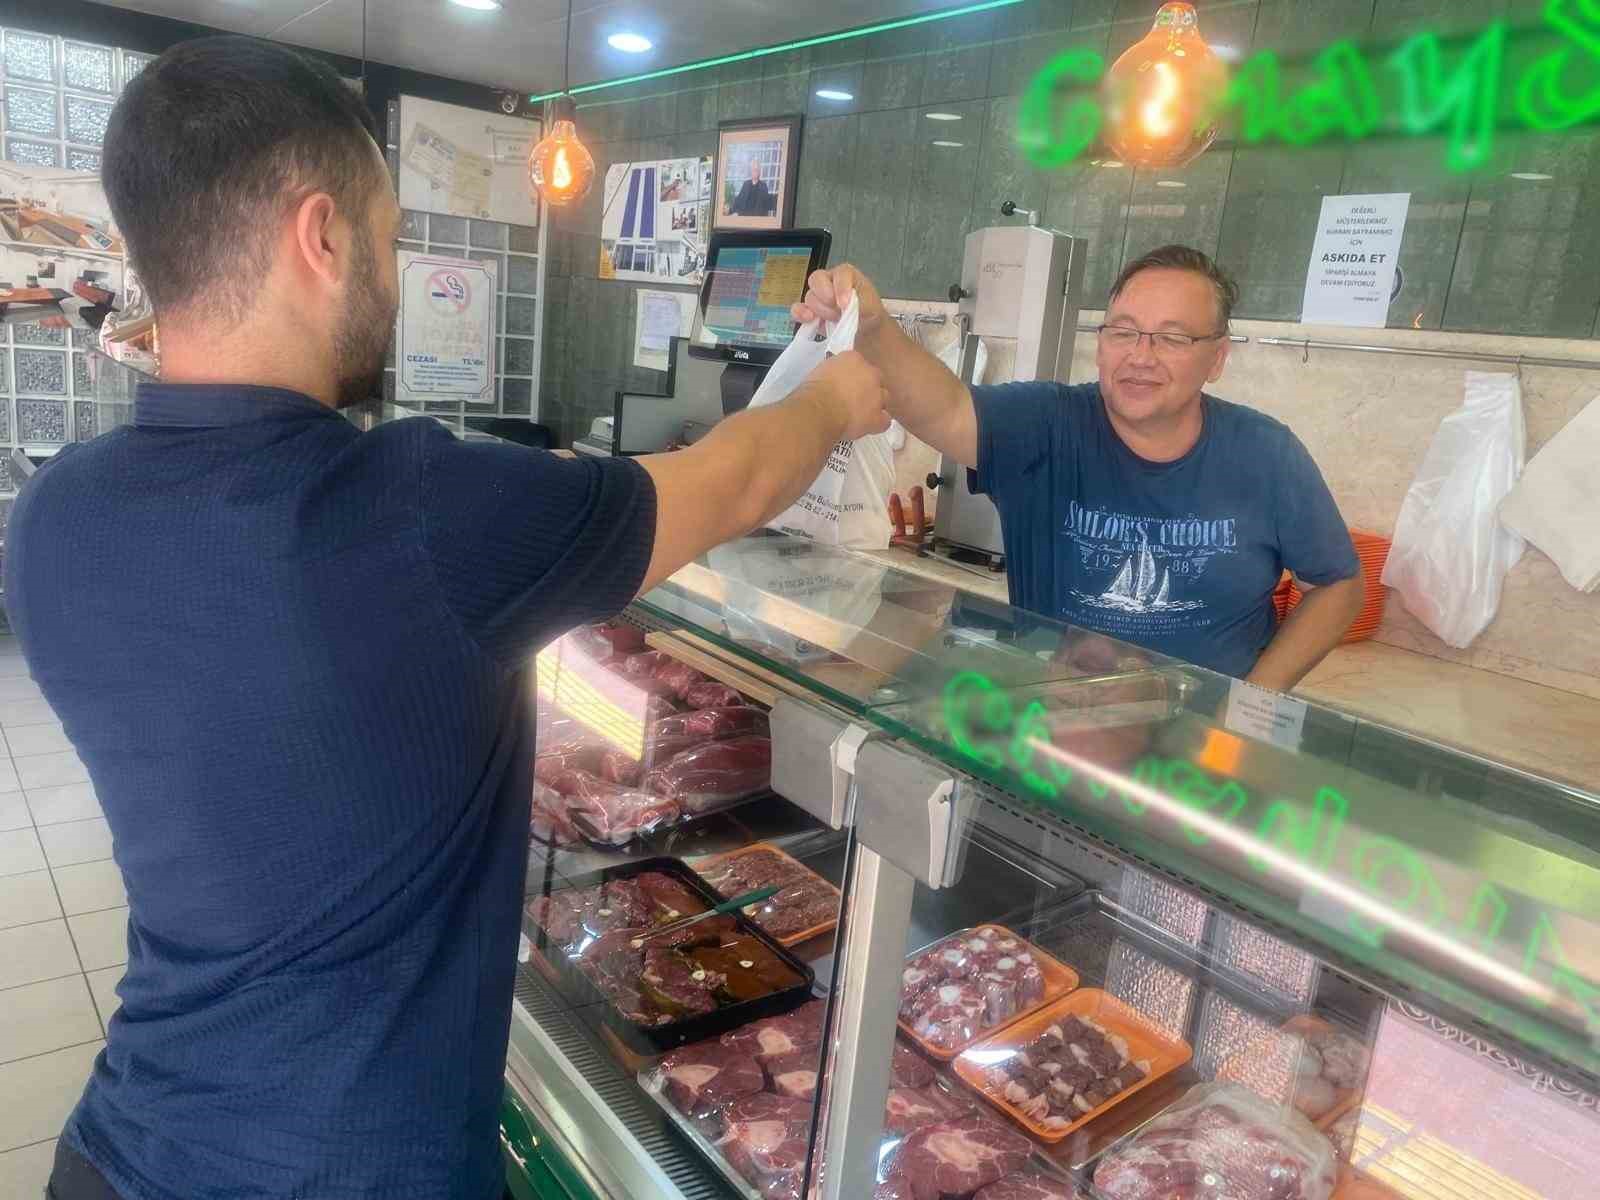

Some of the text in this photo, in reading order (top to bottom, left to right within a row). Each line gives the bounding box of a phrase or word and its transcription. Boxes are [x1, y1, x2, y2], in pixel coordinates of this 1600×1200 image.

[1321, 253, 1387, 263] ASKIDA ET
[1159, 518, 1237, 547] CHOICE
